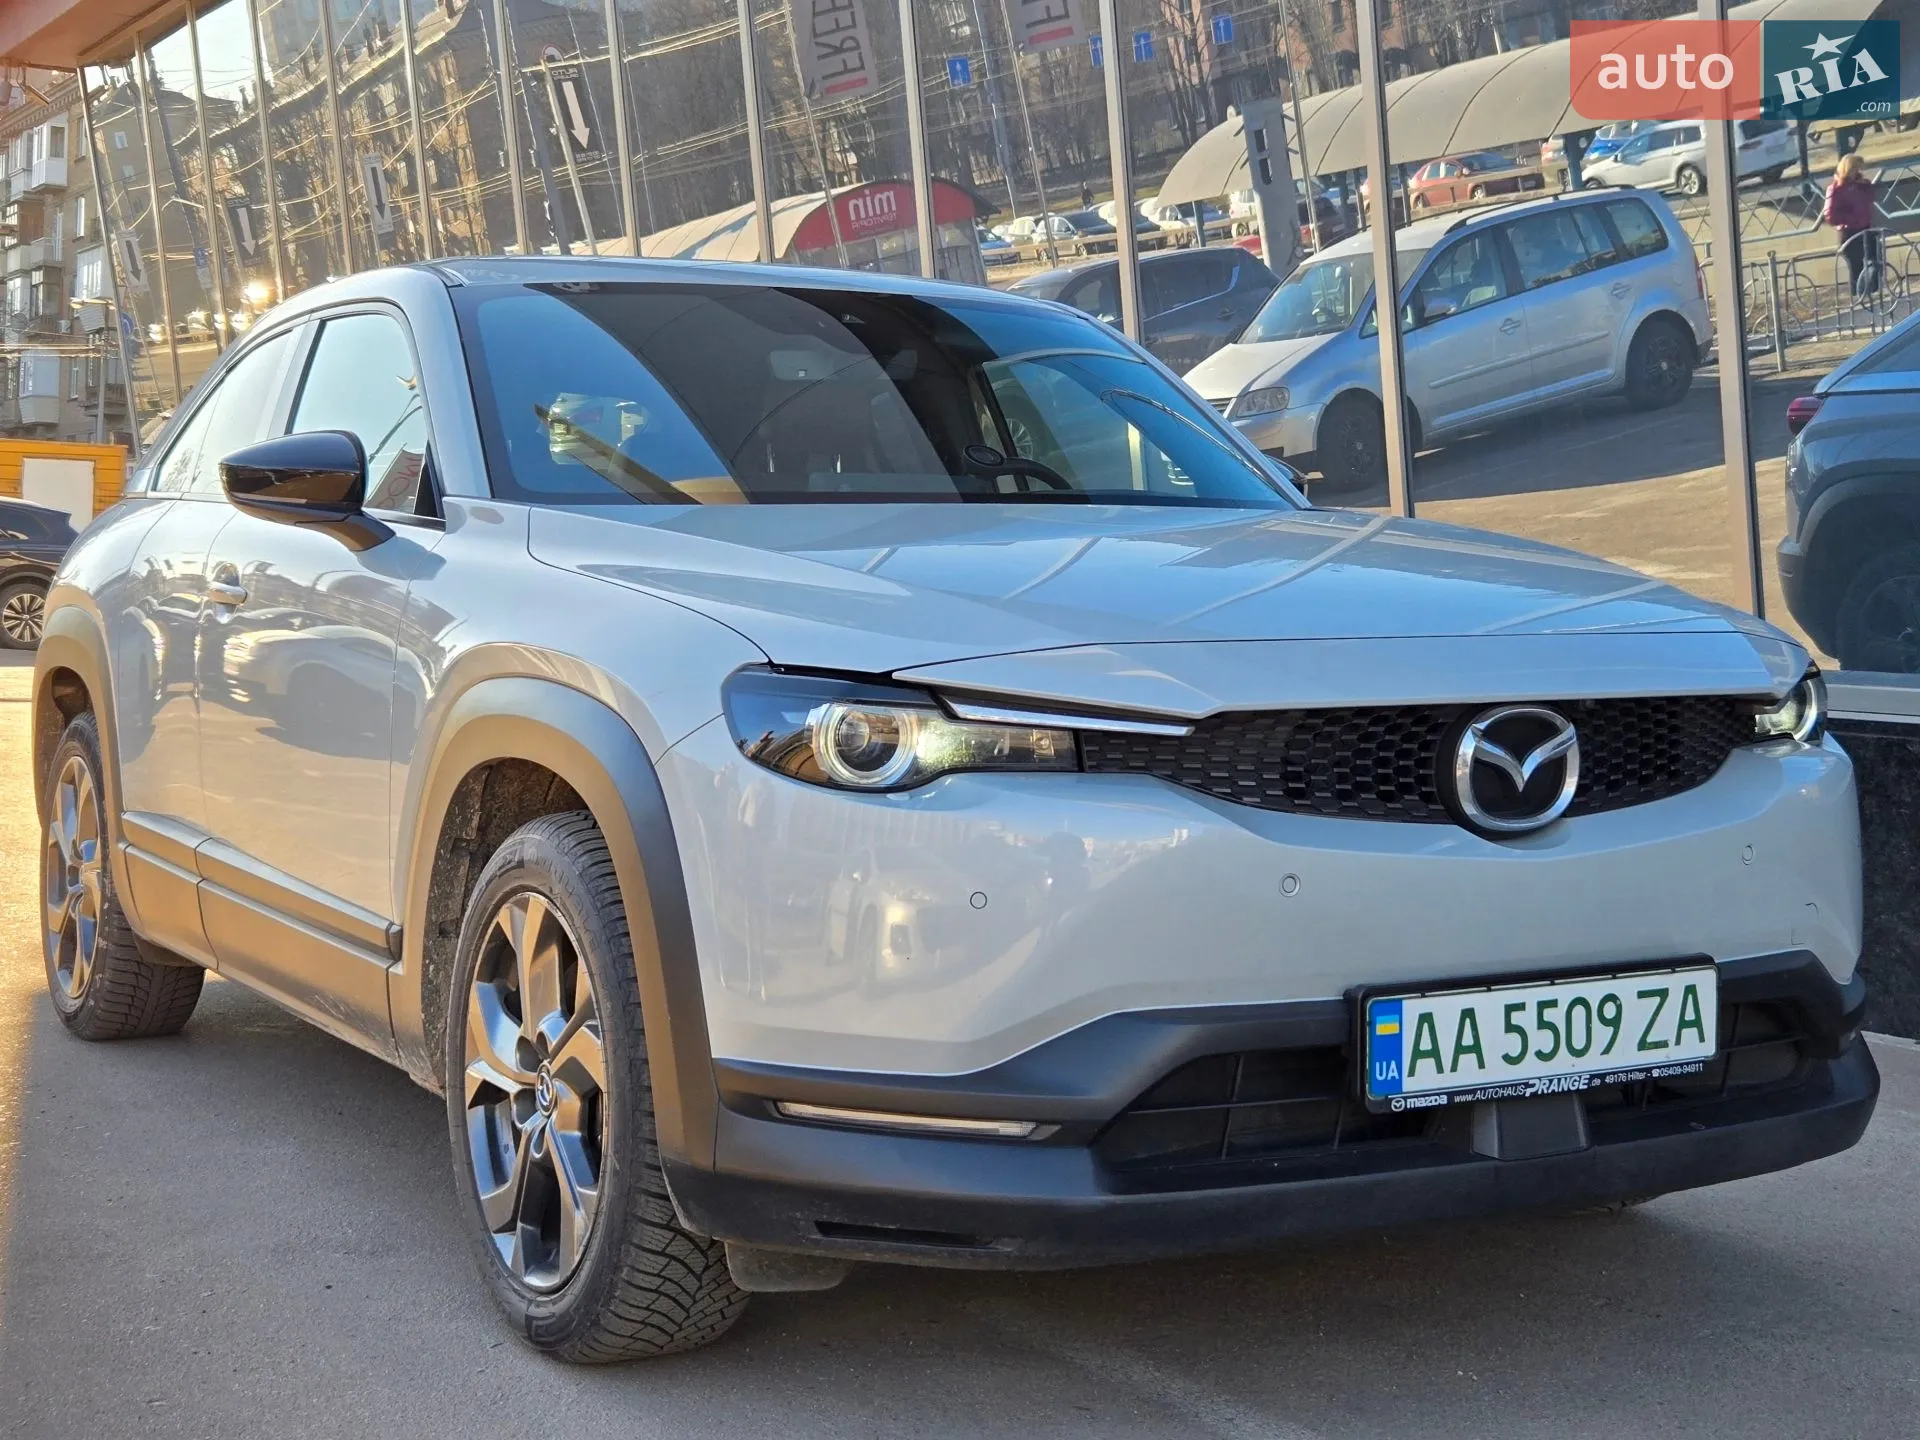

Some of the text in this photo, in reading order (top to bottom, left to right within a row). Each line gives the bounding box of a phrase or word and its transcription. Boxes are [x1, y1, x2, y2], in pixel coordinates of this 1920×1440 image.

[1407, 984, 1706, 1078] AA 5509 ZA
[1375, 1060, 1399, 1081] UA
[1406, 1094, 1448, 1109] mazda
[1605, 1072, 1627, 1084] 49176
[1628, 1069, 1647, 1081] Hilter
